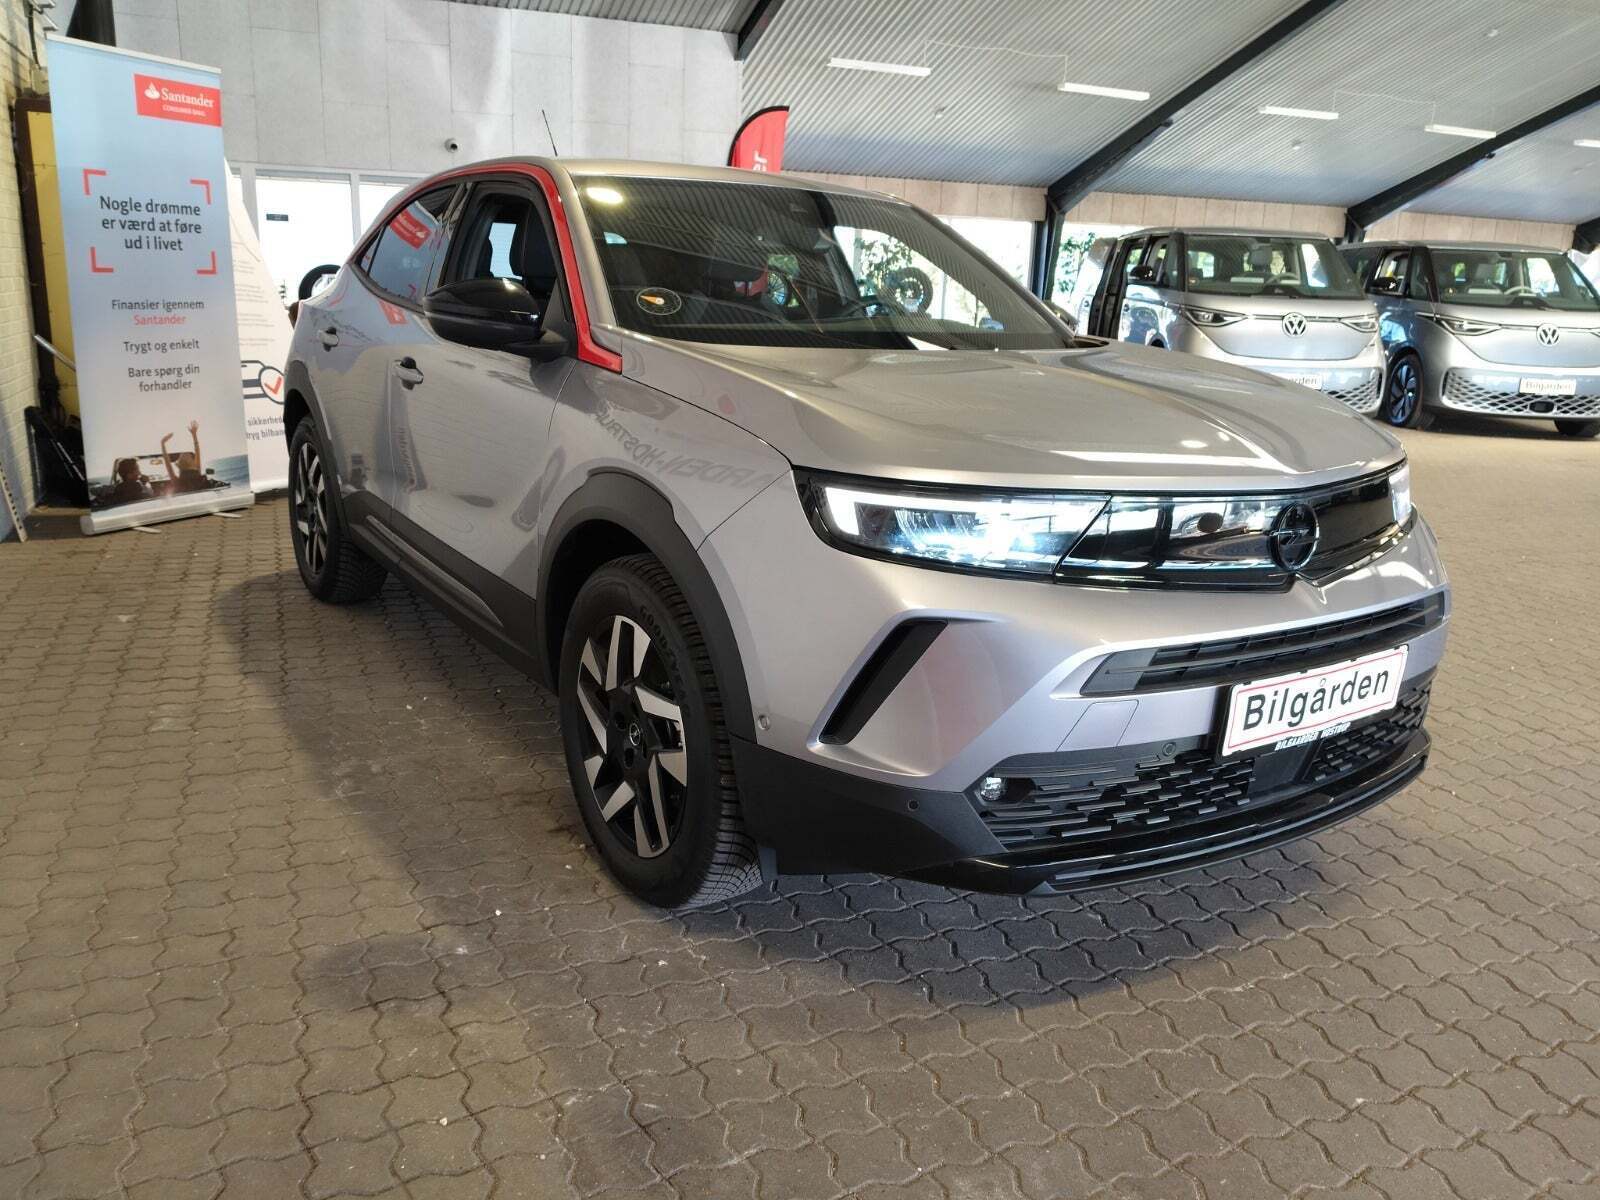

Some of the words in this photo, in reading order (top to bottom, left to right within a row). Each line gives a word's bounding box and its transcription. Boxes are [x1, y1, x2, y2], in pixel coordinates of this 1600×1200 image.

[161, 87, 214, 108] Santander
[100, 195, 142, 215] Nogle
[145, 198, 201, 216] drømme
[102, 218, 116, 229] er
[119, 217, 155, 231] værd
[159, 219, 172, 232] at
[174, 219, 202, 233] føre
[124, 235, 142, 249] ud
[154, 236, 183, 251] livet
[111, 299, 160, 310] Finansier
[162, 299, 205, 312] igennem
[134, 313, 187, 326] Santander
[123, 341, 152, 354] Trygt
[154, 341, 168, 353] og
[169, 338, 200, 350] enkelt
[128, 367, 152, 378] Bare
[154, 366, 184, 378] spørg
[185, 363, 200, 375] din
[139, 380, 192, 392] forhandler
[1243, 669, 1389, 728] Bilgården
